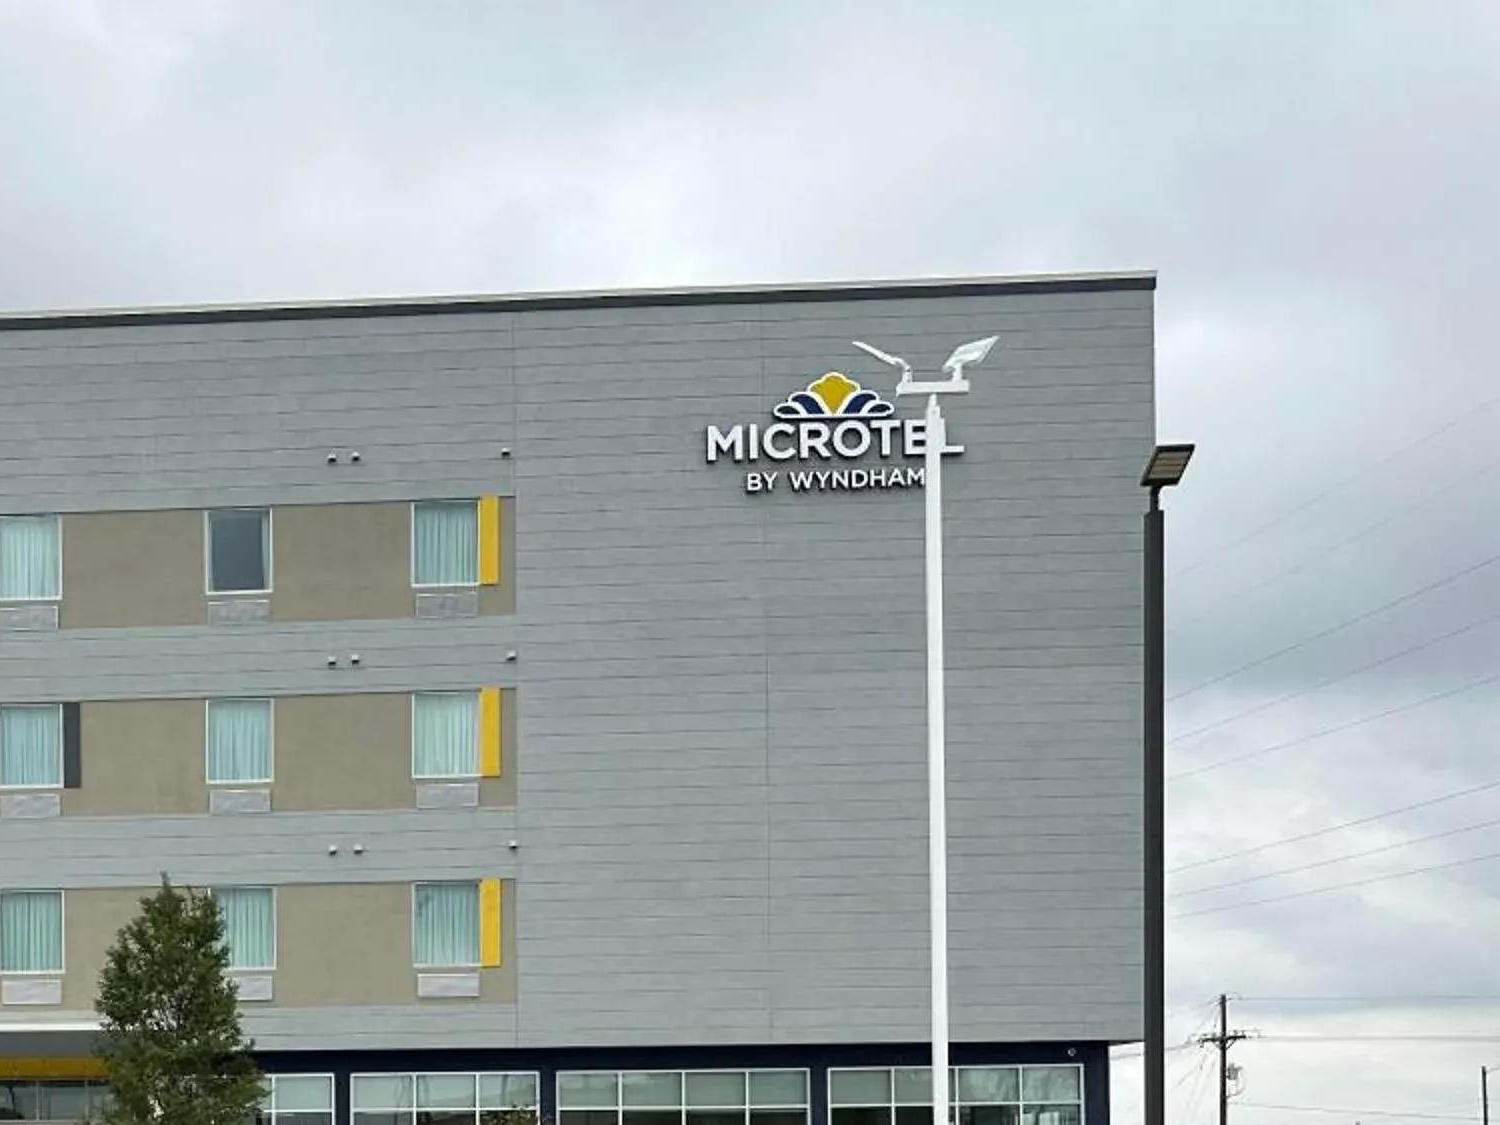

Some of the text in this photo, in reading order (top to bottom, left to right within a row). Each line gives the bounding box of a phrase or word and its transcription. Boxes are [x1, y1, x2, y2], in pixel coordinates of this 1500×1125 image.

[707, 418, 965, 461] MICROTEL
[747, 467, 926, 491] BY WYNDHAM
